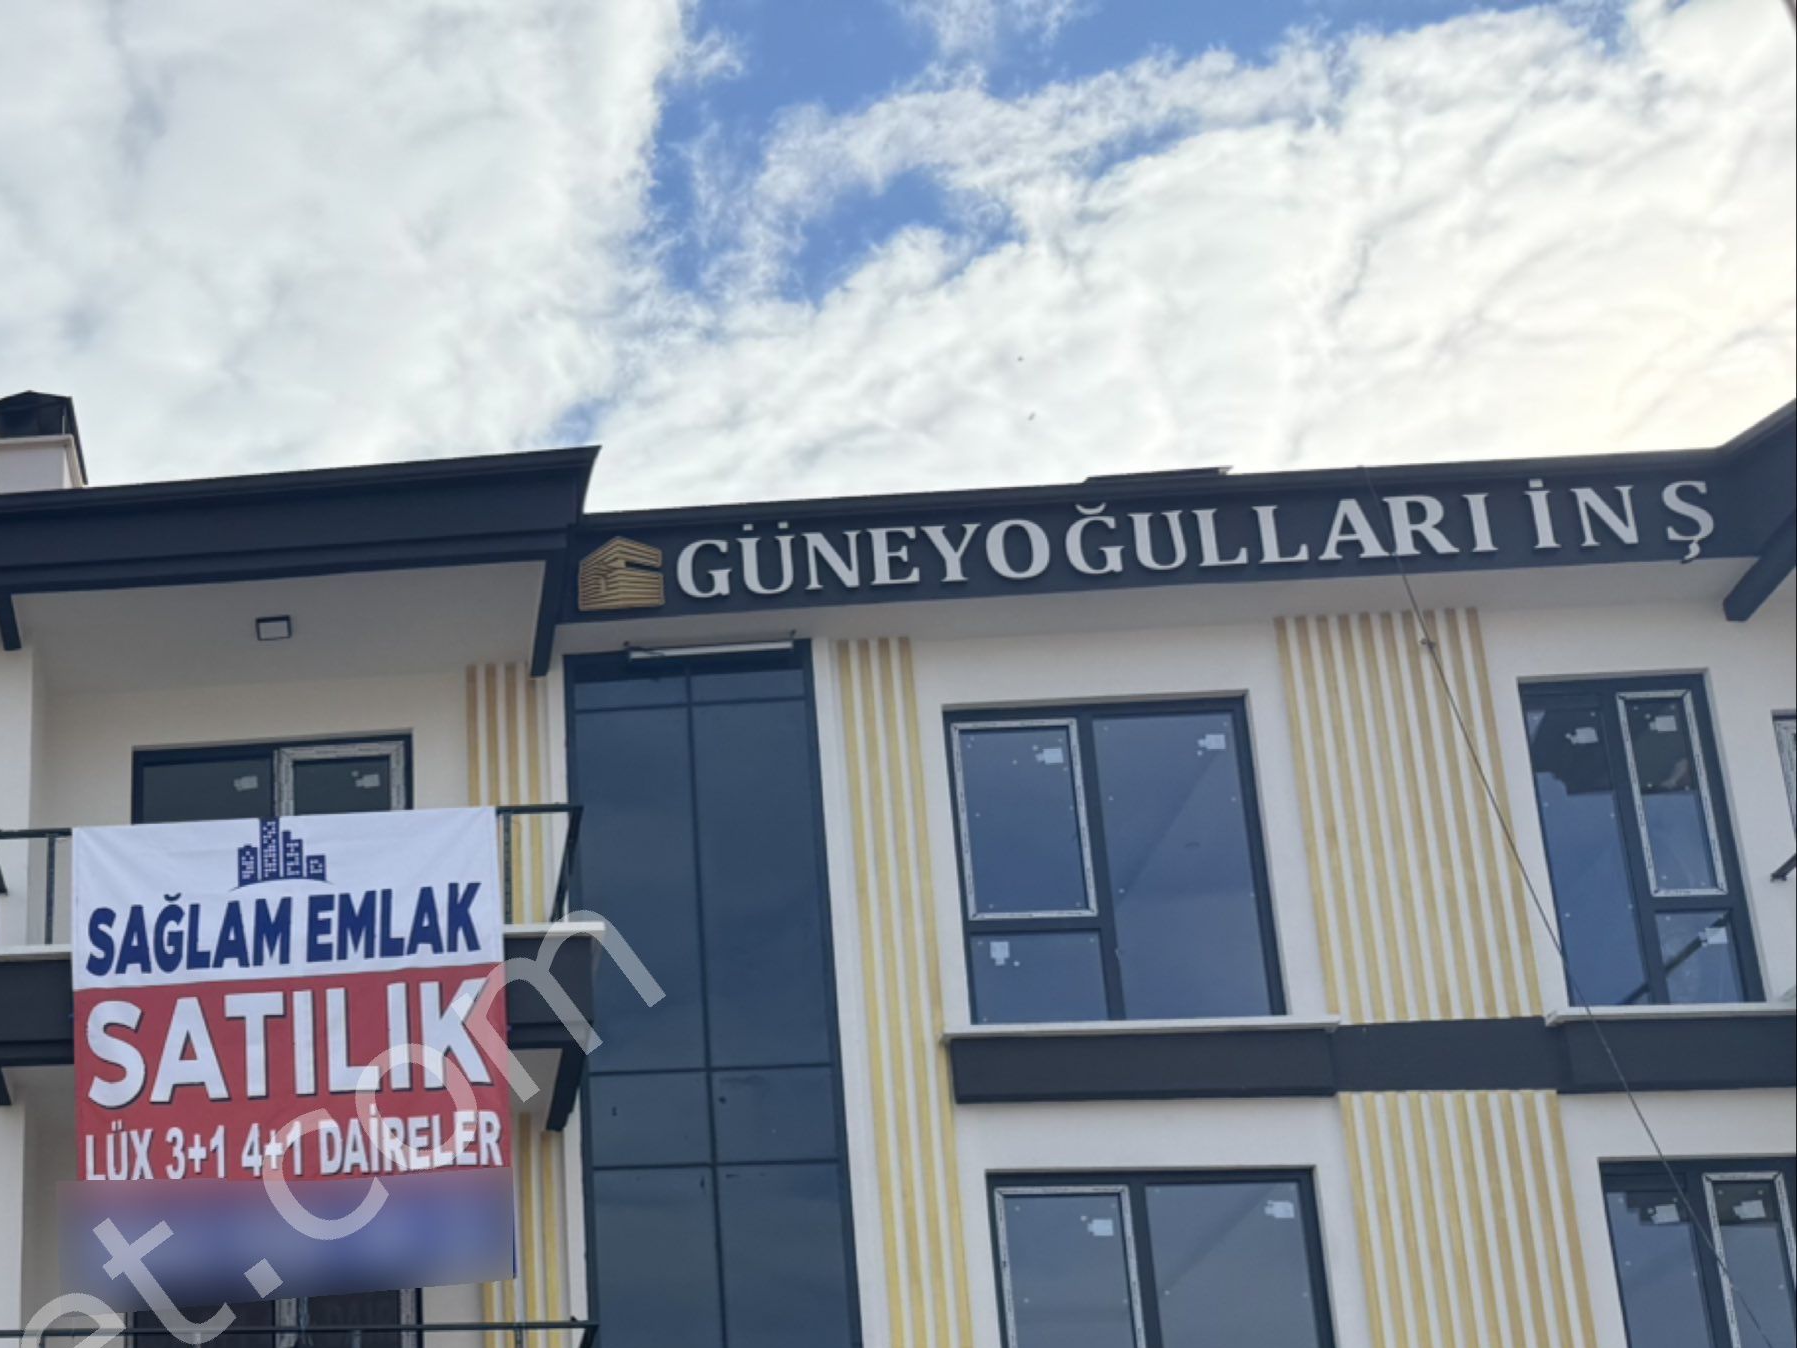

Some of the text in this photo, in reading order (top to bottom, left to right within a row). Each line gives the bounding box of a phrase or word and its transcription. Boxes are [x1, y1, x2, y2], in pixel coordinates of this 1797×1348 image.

[676, 493, 1499, 600] GÜNEYOĞULLARI
[85, 881, 483, 977] SAĞLAM EMLAK
[87, 978, 494, 1107] SATILIK
[85, 1103, 503, 1181] LÜX 3+1 4+1 DAİRELER
